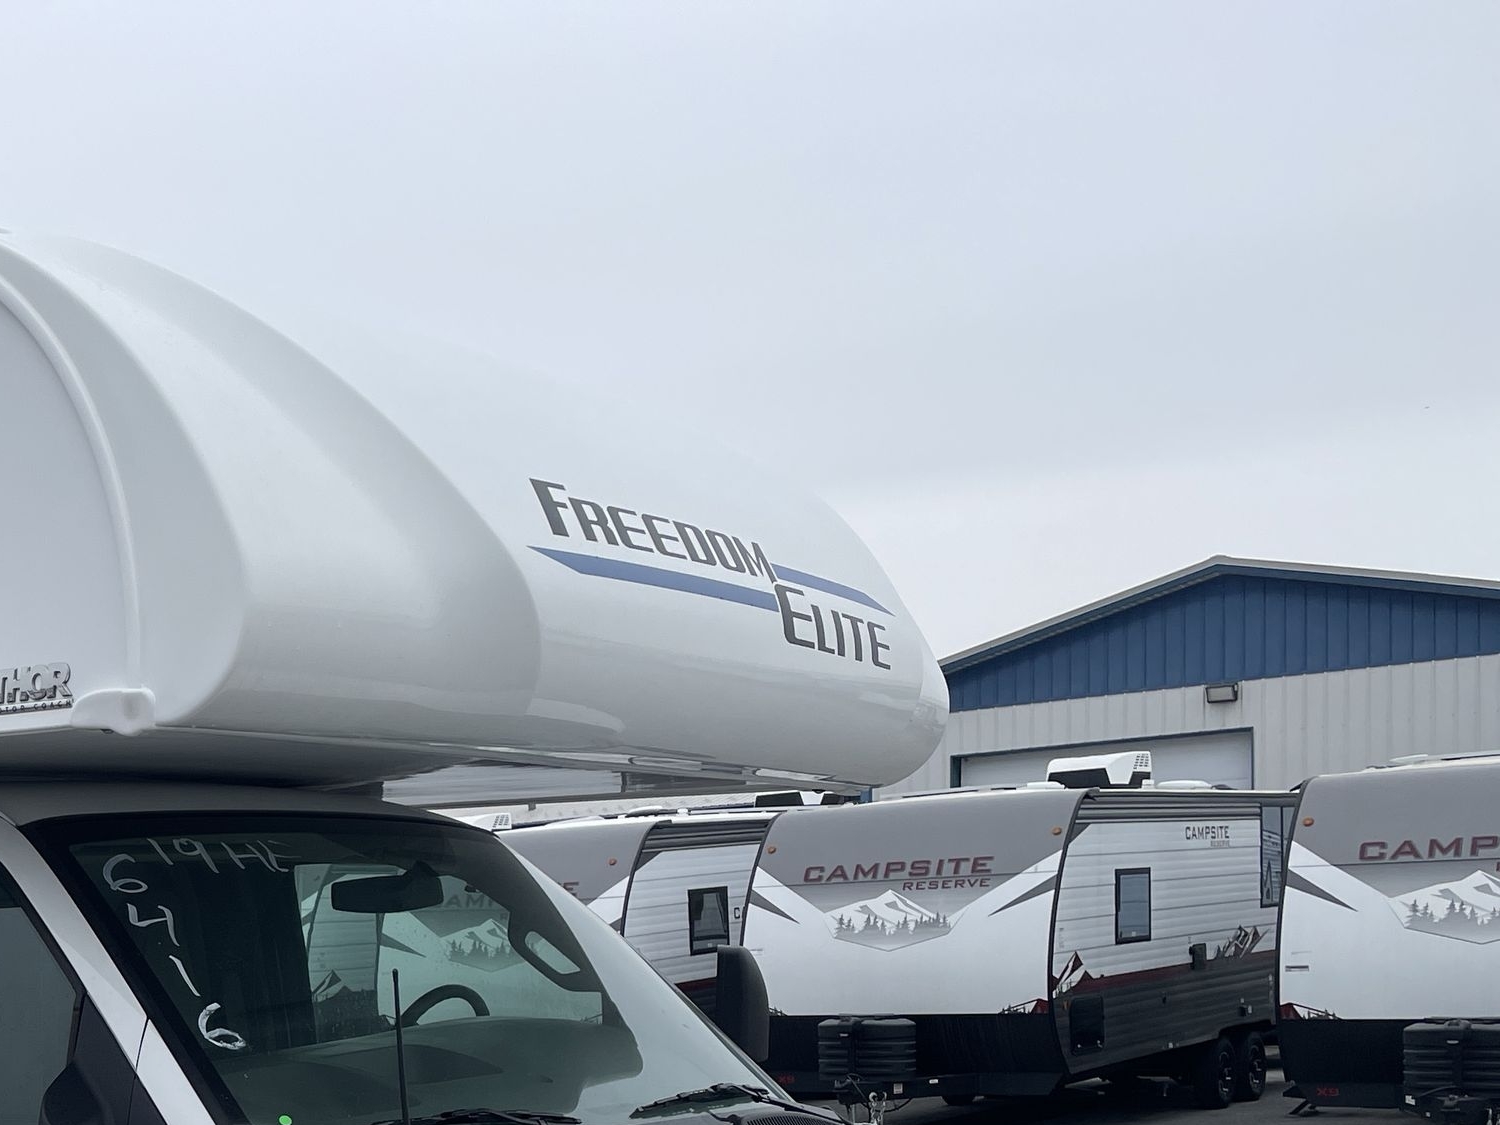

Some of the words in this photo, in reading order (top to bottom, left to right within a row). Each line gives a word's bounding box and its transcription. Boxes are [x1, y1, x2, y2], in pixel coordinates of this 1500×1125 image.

[529, 477, 777, 584] FREEDOM
[774, 583, 892, 671] ELITE
[1185, 825, 1229, 840] CAMPSITE
[803, 856, 994, 883] CAMPSITE
[902, 878, 991, 891] RESERVE
